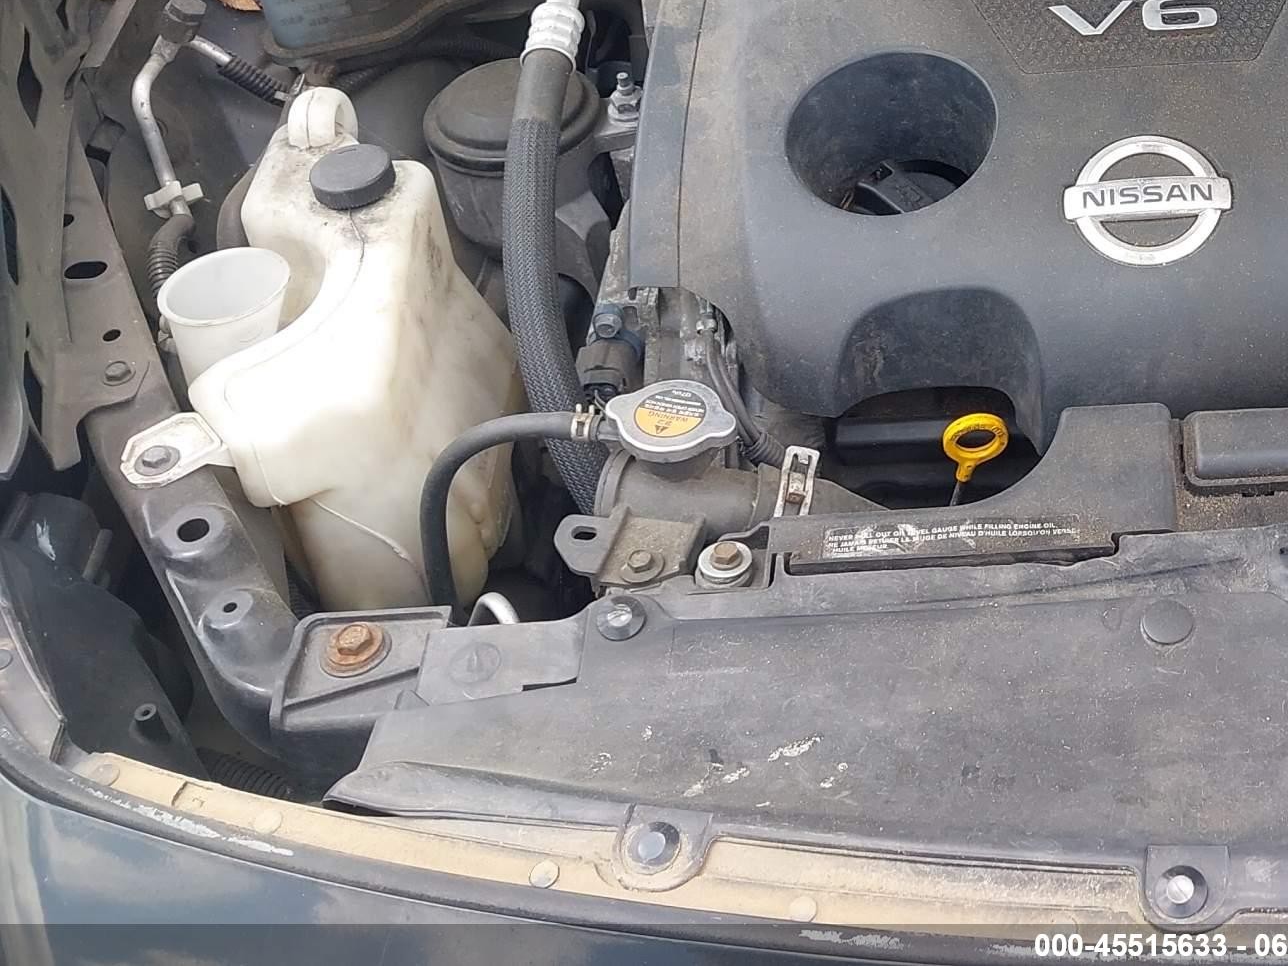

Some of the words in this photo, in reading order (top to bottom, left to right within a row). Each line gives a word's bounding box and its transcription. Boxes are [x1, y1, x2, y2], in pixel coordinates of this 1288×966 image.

[1082, 183, 1214, 210] NISSAN
[648, 411, 688, 423] WARNING
[828, 534, 854, 542] NEVER
[875, 530, 892, 538] OUT
[932, 526, 958, 534] GAUGE
[959, 524, 983, 532] WHILE
